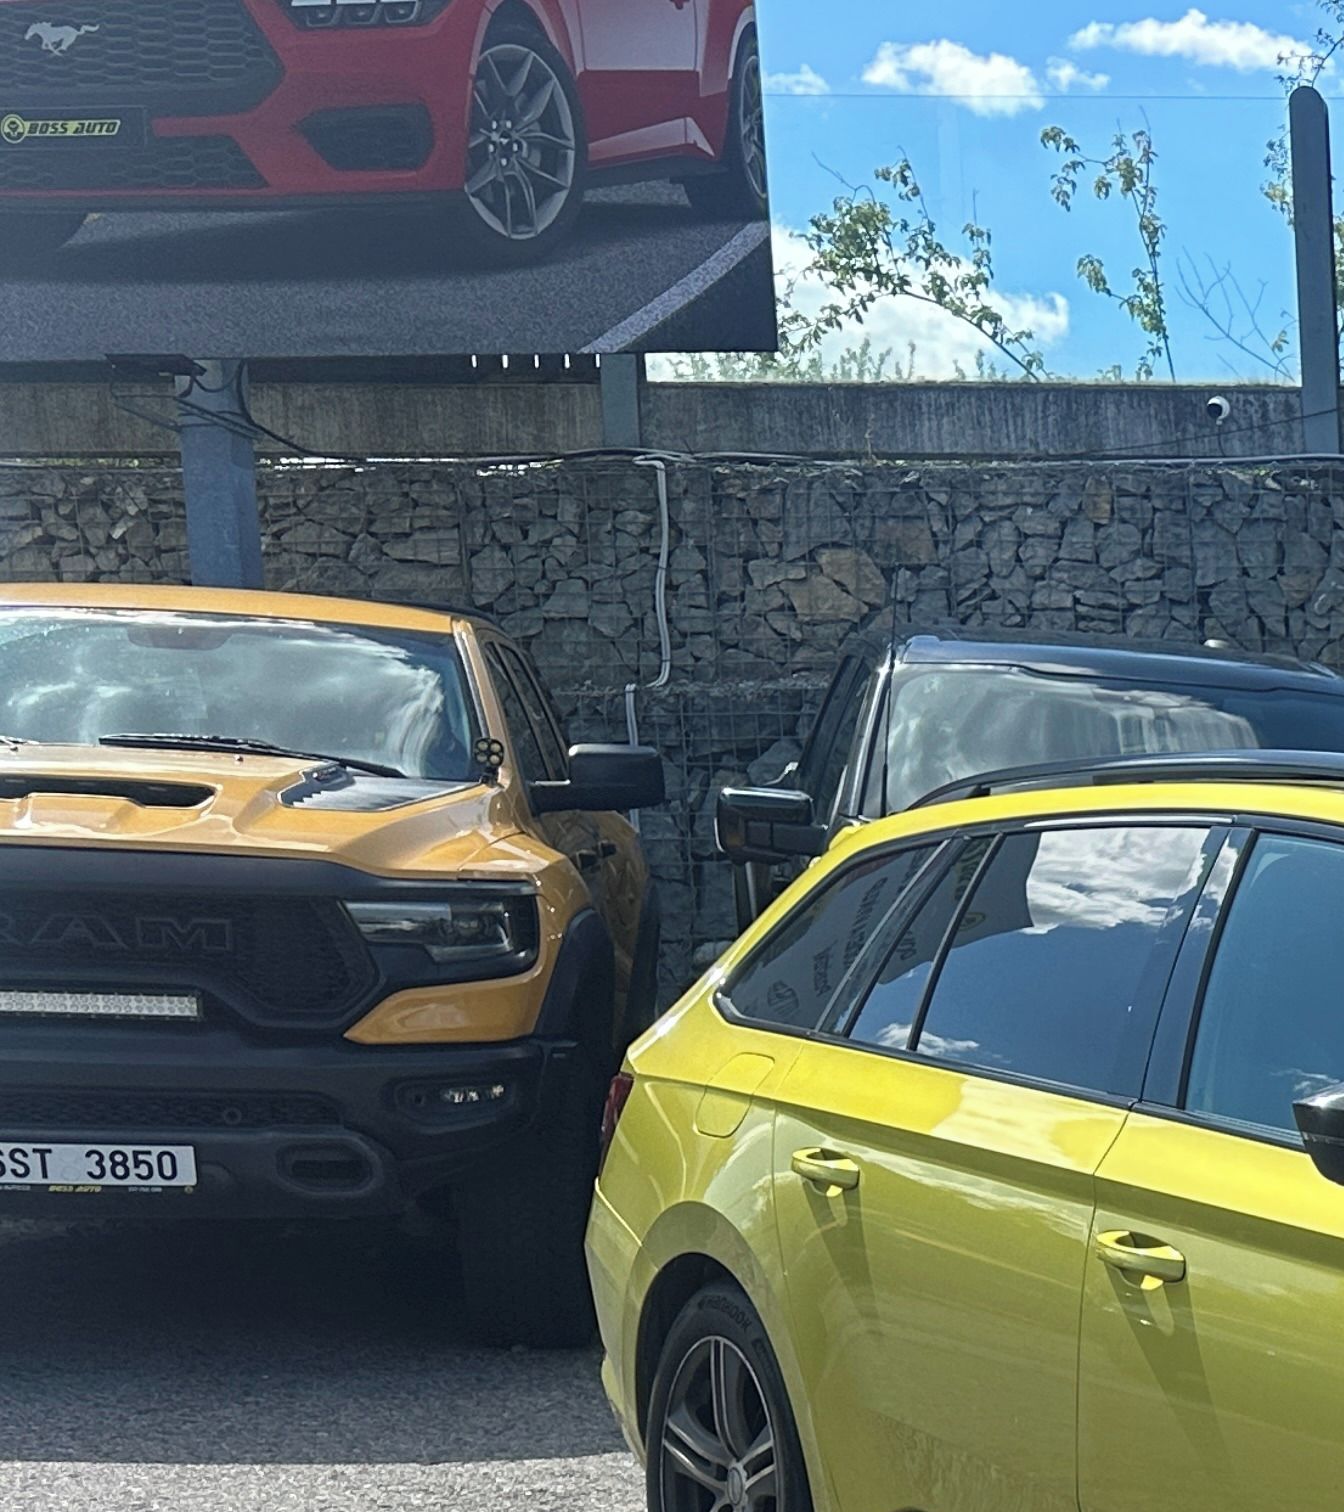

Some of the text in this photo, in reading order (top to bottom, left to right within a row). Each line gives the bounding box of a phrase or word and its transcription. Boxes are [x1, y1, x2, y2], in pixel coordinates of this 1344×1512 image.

[27, 121, 118, 135] BOSS AUTO
[85, 1149, 178, 1181] 3850
